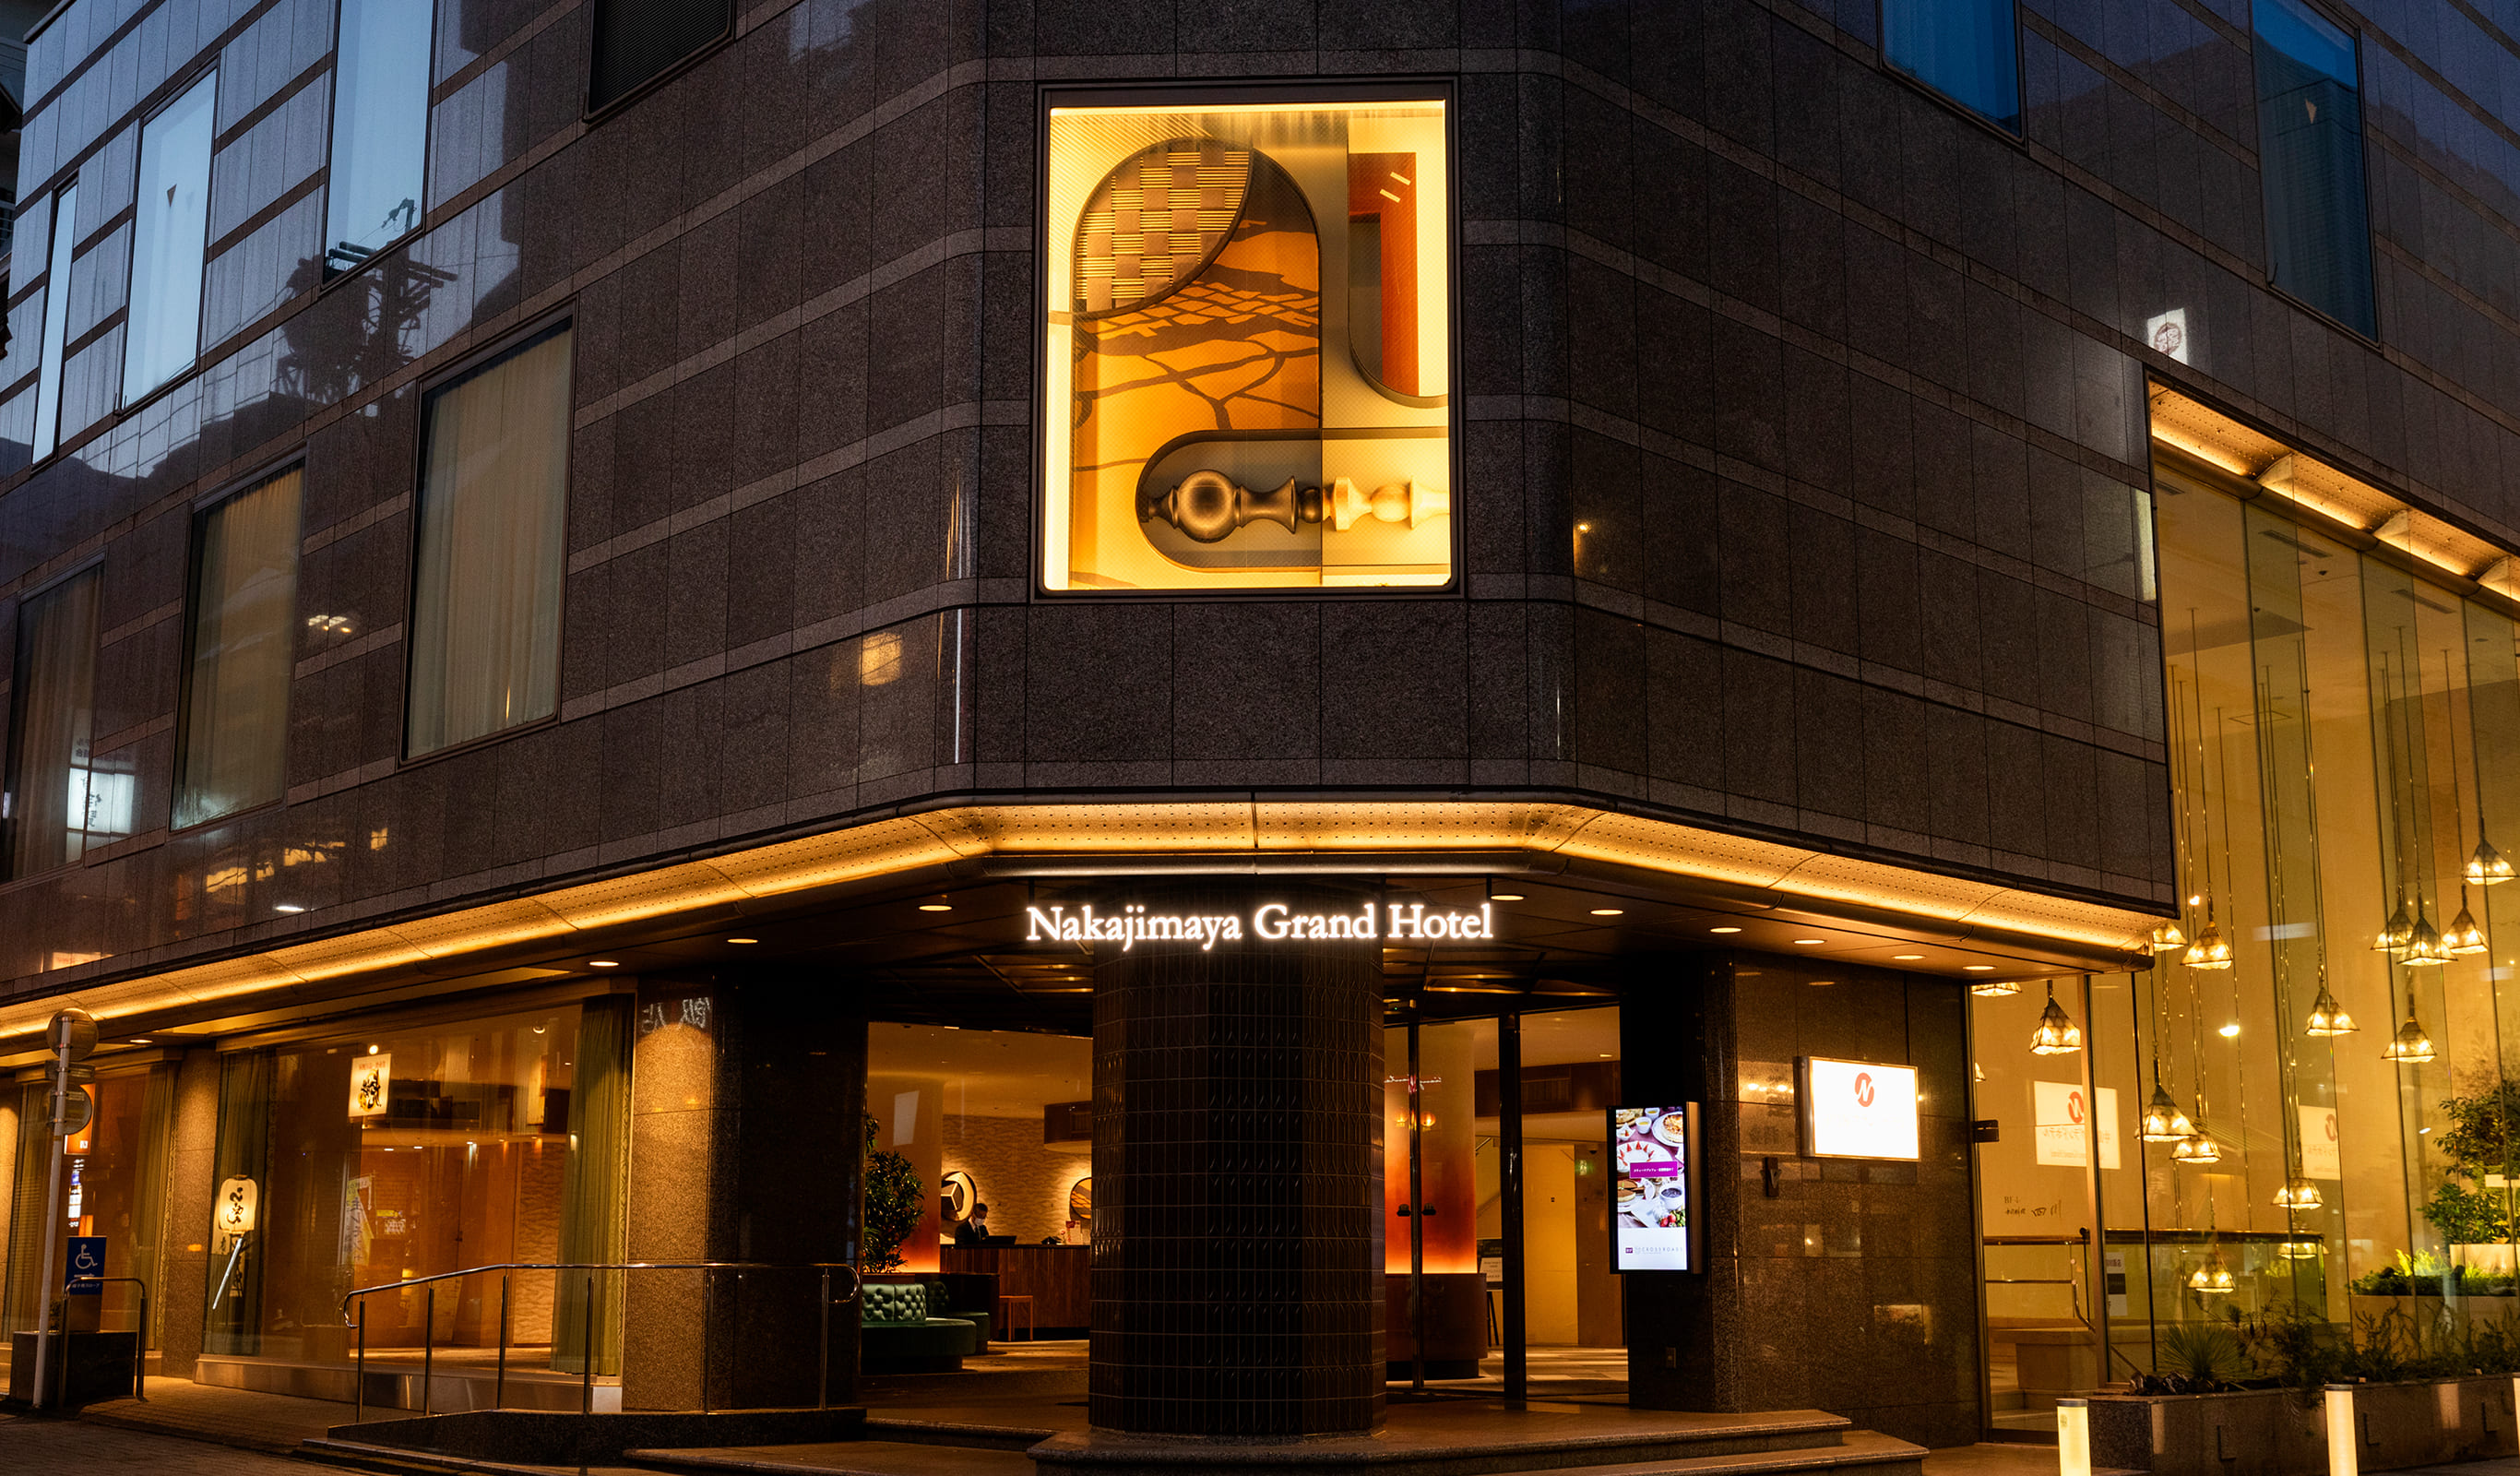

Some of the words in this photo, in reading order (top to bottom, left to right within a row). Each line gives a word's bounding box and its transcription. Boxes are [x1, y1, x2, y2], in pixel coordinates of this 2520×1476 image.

[1027, 906, 1242, 951] Nakajimaya
[1255, 904, 1377, 939] Grand
[1388, 903, 1493, 940] Hotel
